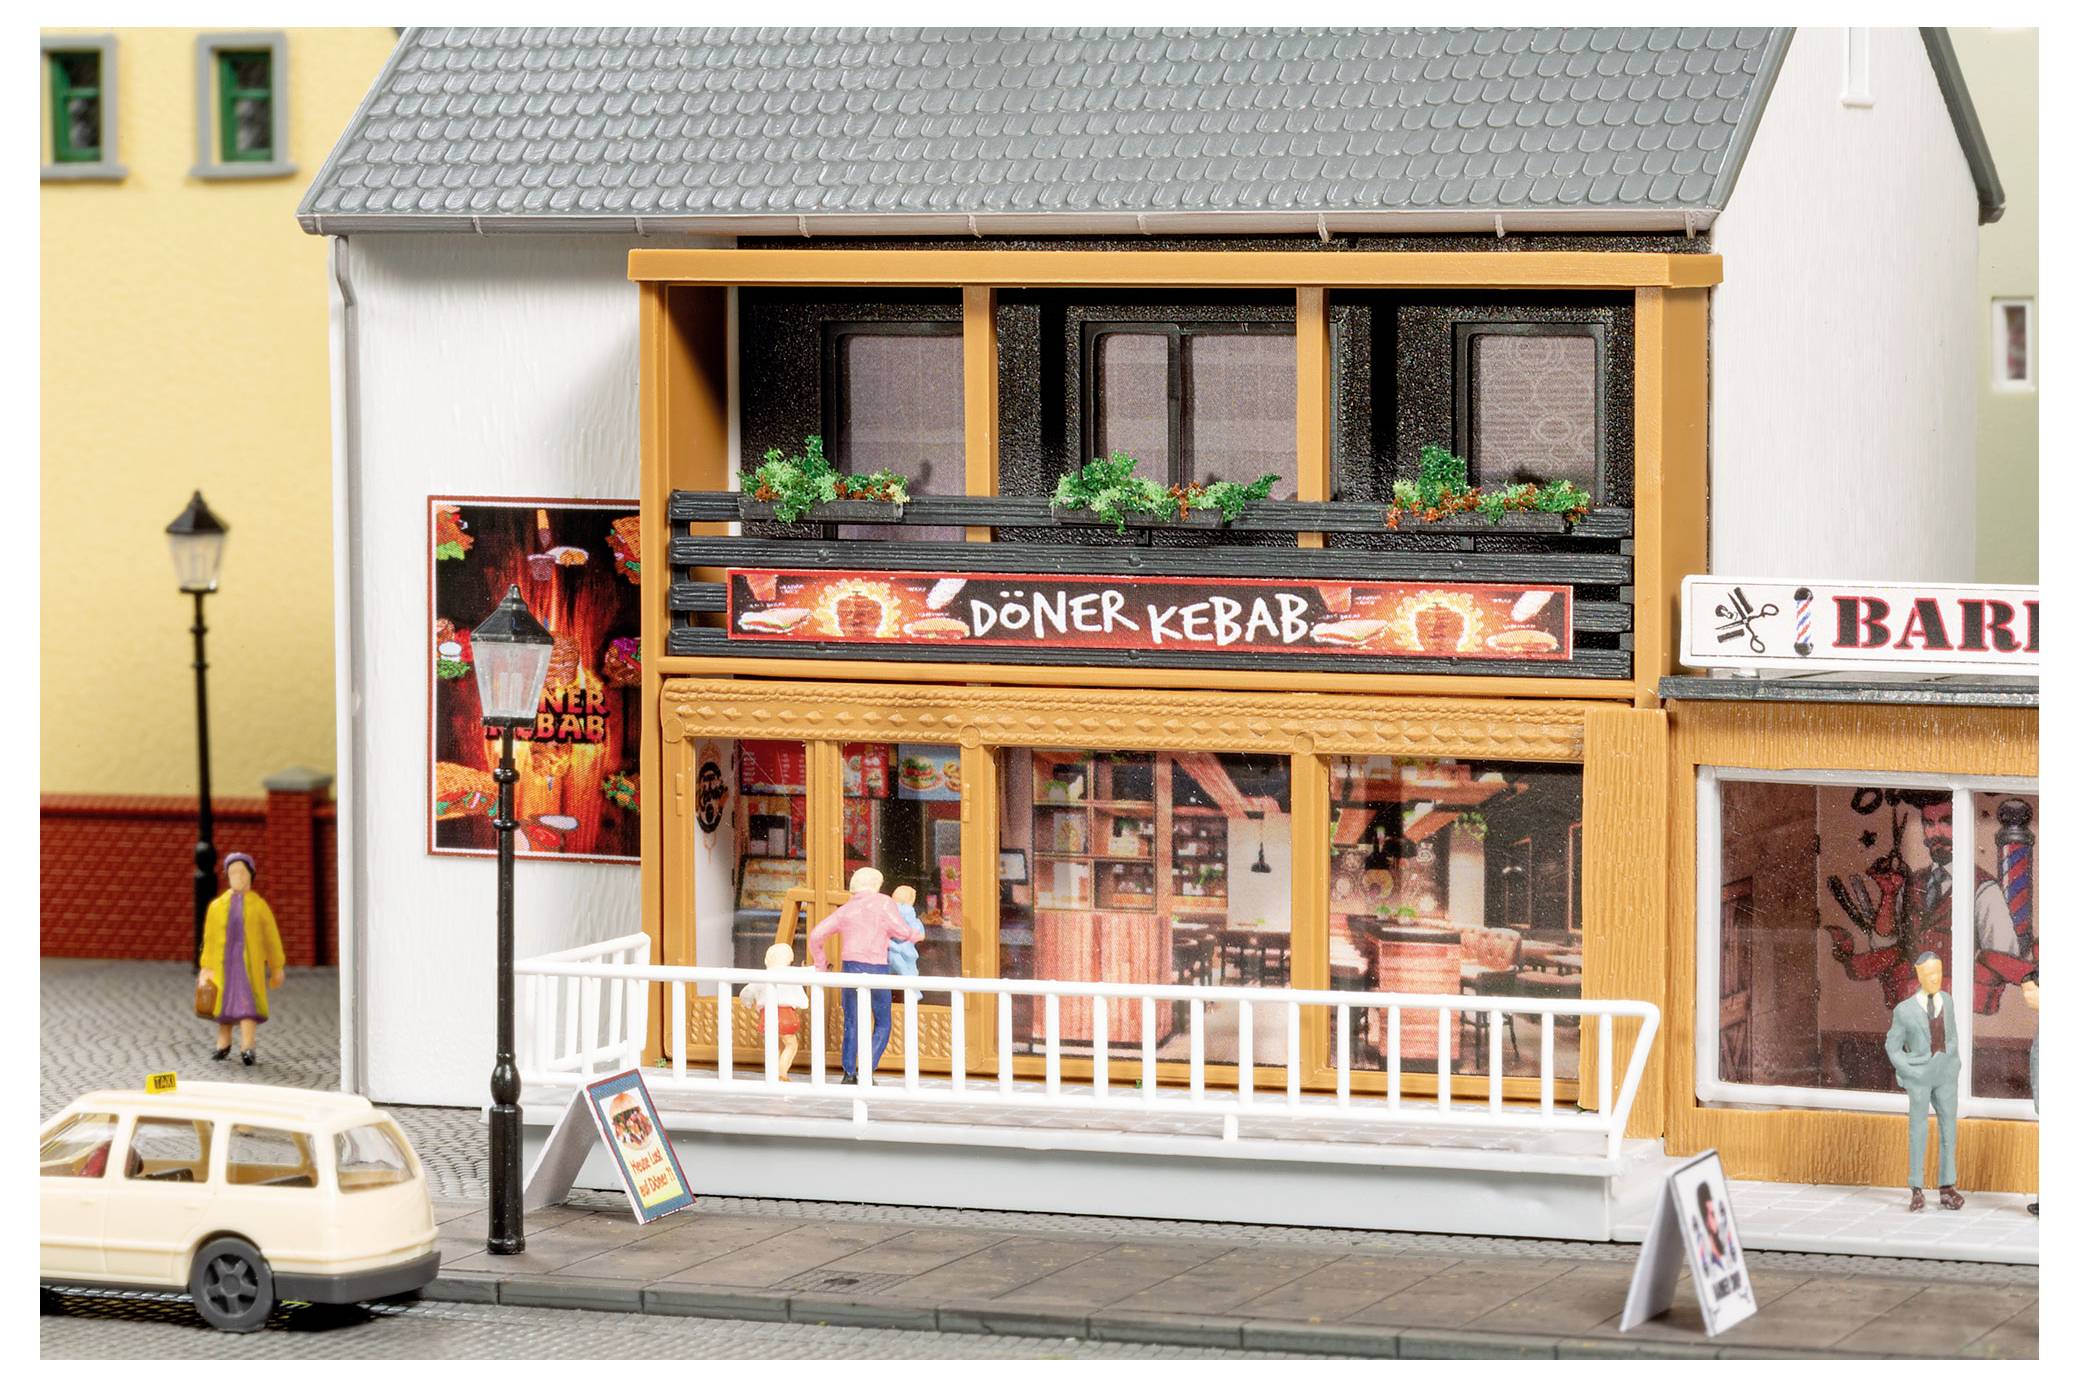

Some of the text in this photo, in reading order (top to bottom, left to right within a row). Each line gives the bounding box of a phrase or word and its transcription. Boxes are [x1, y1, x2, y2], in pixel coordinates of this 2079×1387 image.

[970, 590, 1309, 646] DÖNER KEBAB
[1832, 595, 2039, 653] BAR
[537, 687, 610, 715] NER
[487, 713, 606, 743] BAB
[153, 1074, 176, 1089] TAXI
